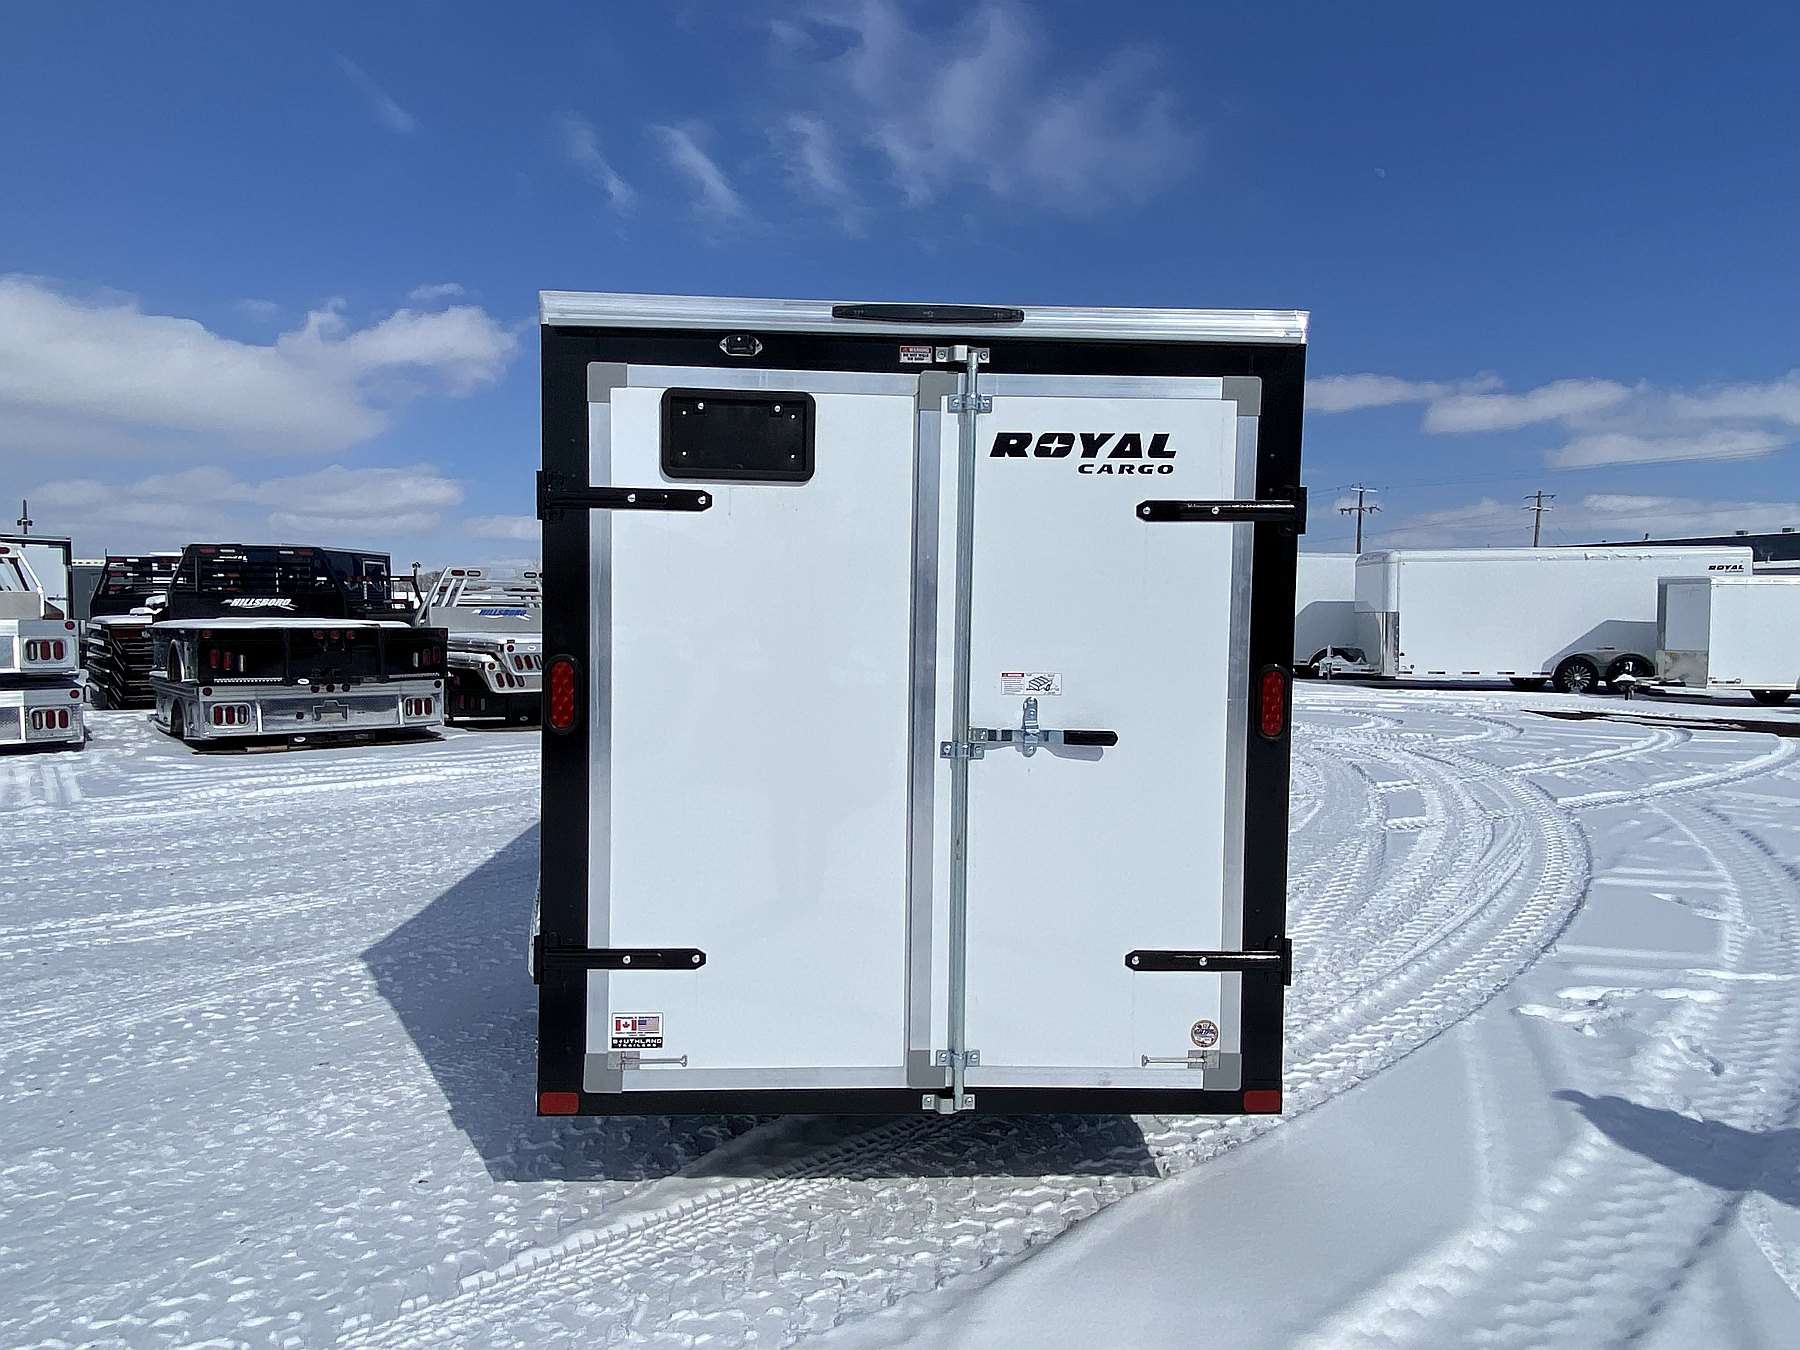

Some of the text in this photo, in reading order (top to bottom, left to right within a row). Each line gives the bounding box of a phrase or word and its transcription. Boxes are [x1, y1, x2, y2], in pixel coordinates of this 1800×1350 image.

[990, 432, 1177, 459] ROYAL
[1078, 464, 1174, 475] CARGO
[230, 598, 292, 607] HILLSBORO
